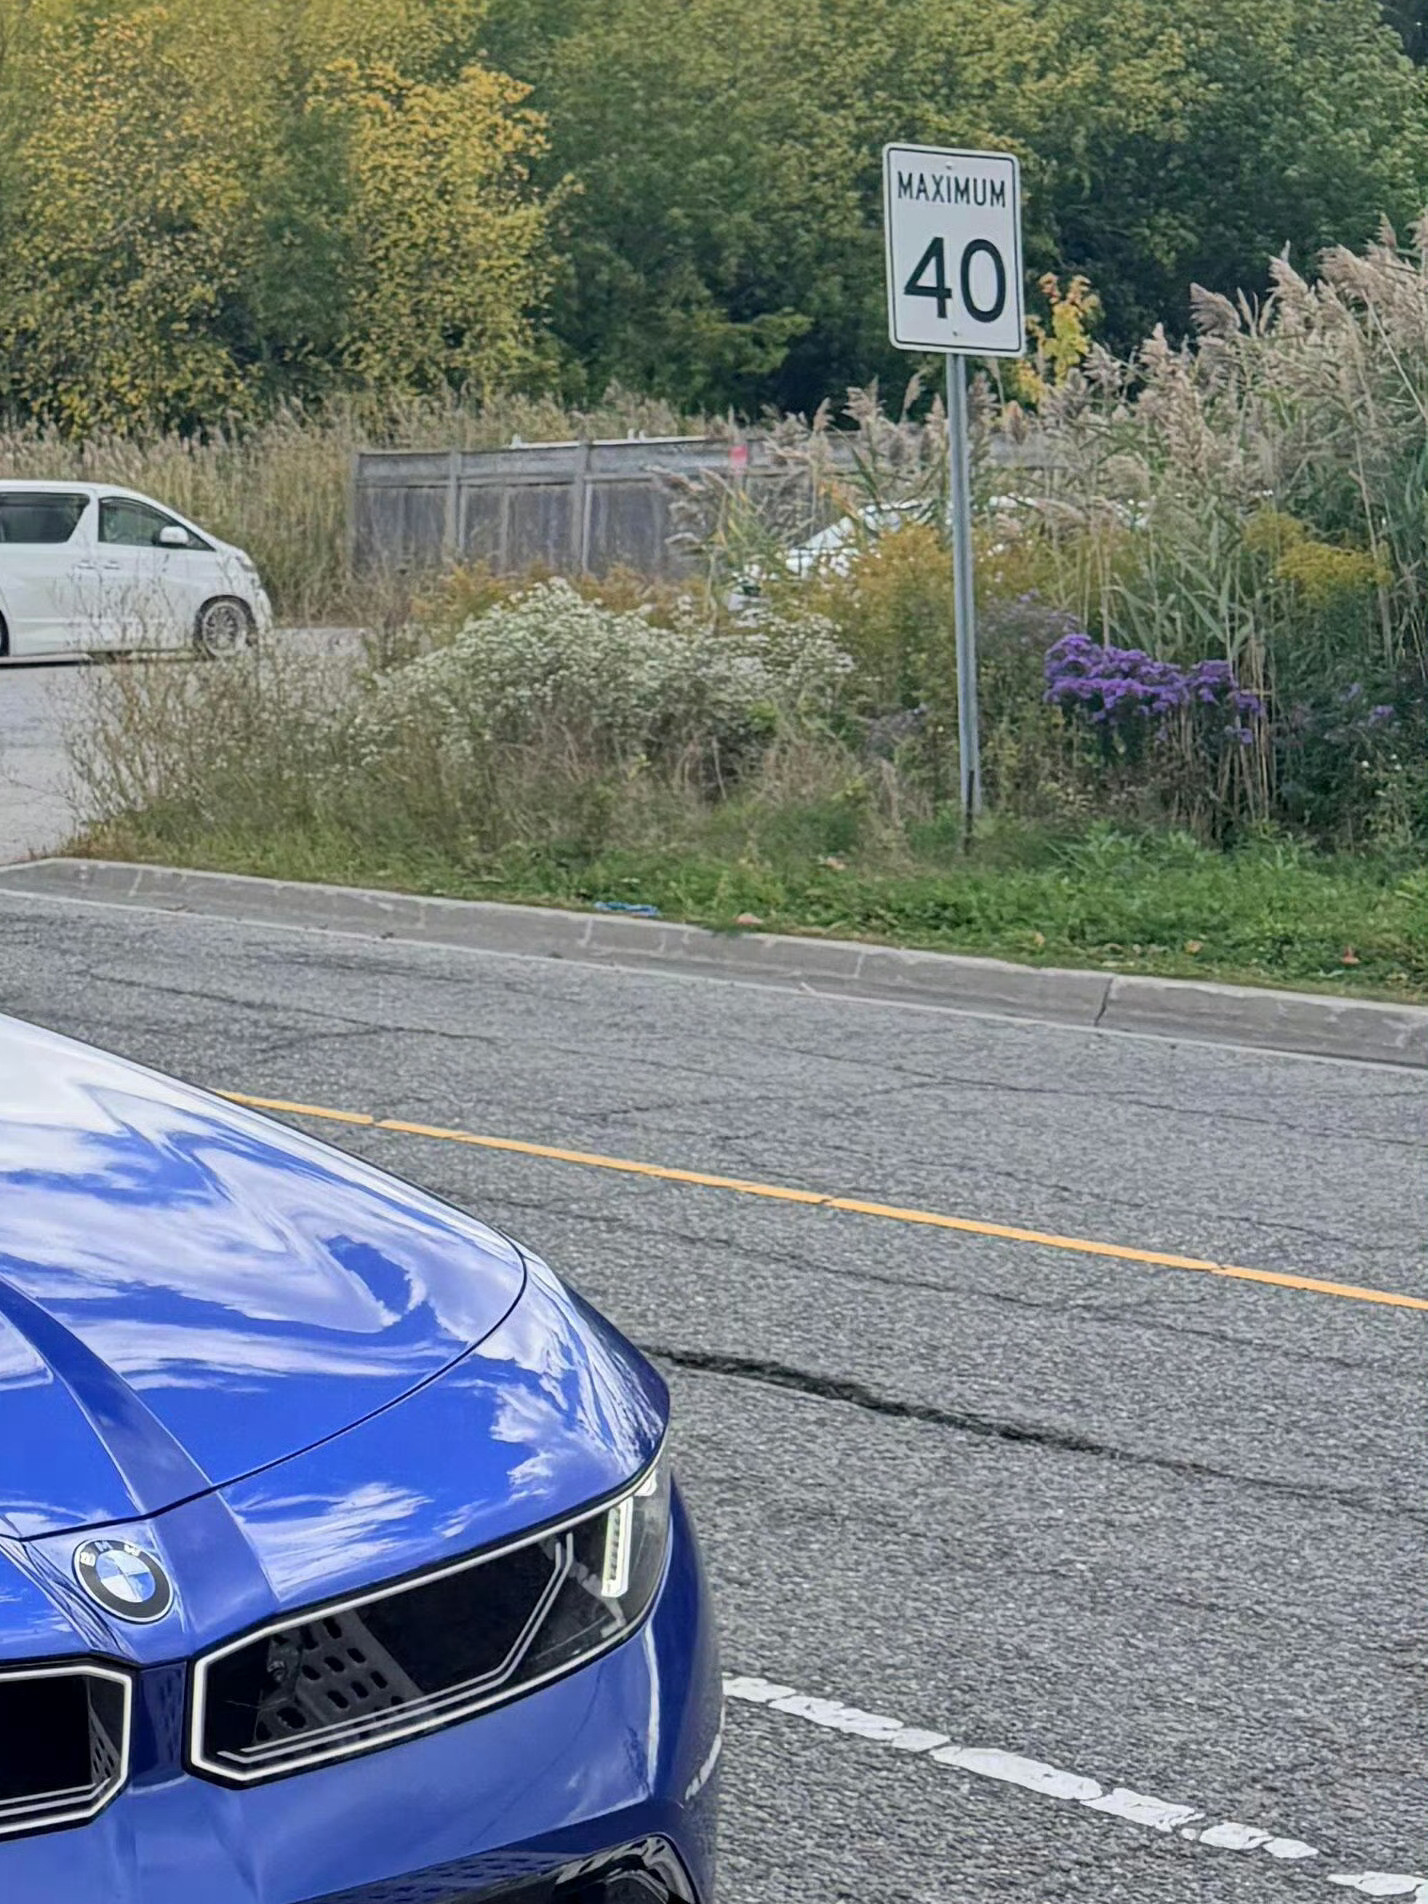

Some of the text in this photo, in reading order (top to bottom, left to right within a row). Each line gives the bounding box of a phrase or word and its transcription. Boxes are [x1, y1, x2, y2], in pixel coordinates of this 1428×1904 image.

[897, 170, 1006, 209] MAXIMUM
[903, 236, 1007, 324] 40
[79, 1540, 142, 1568] BMW
